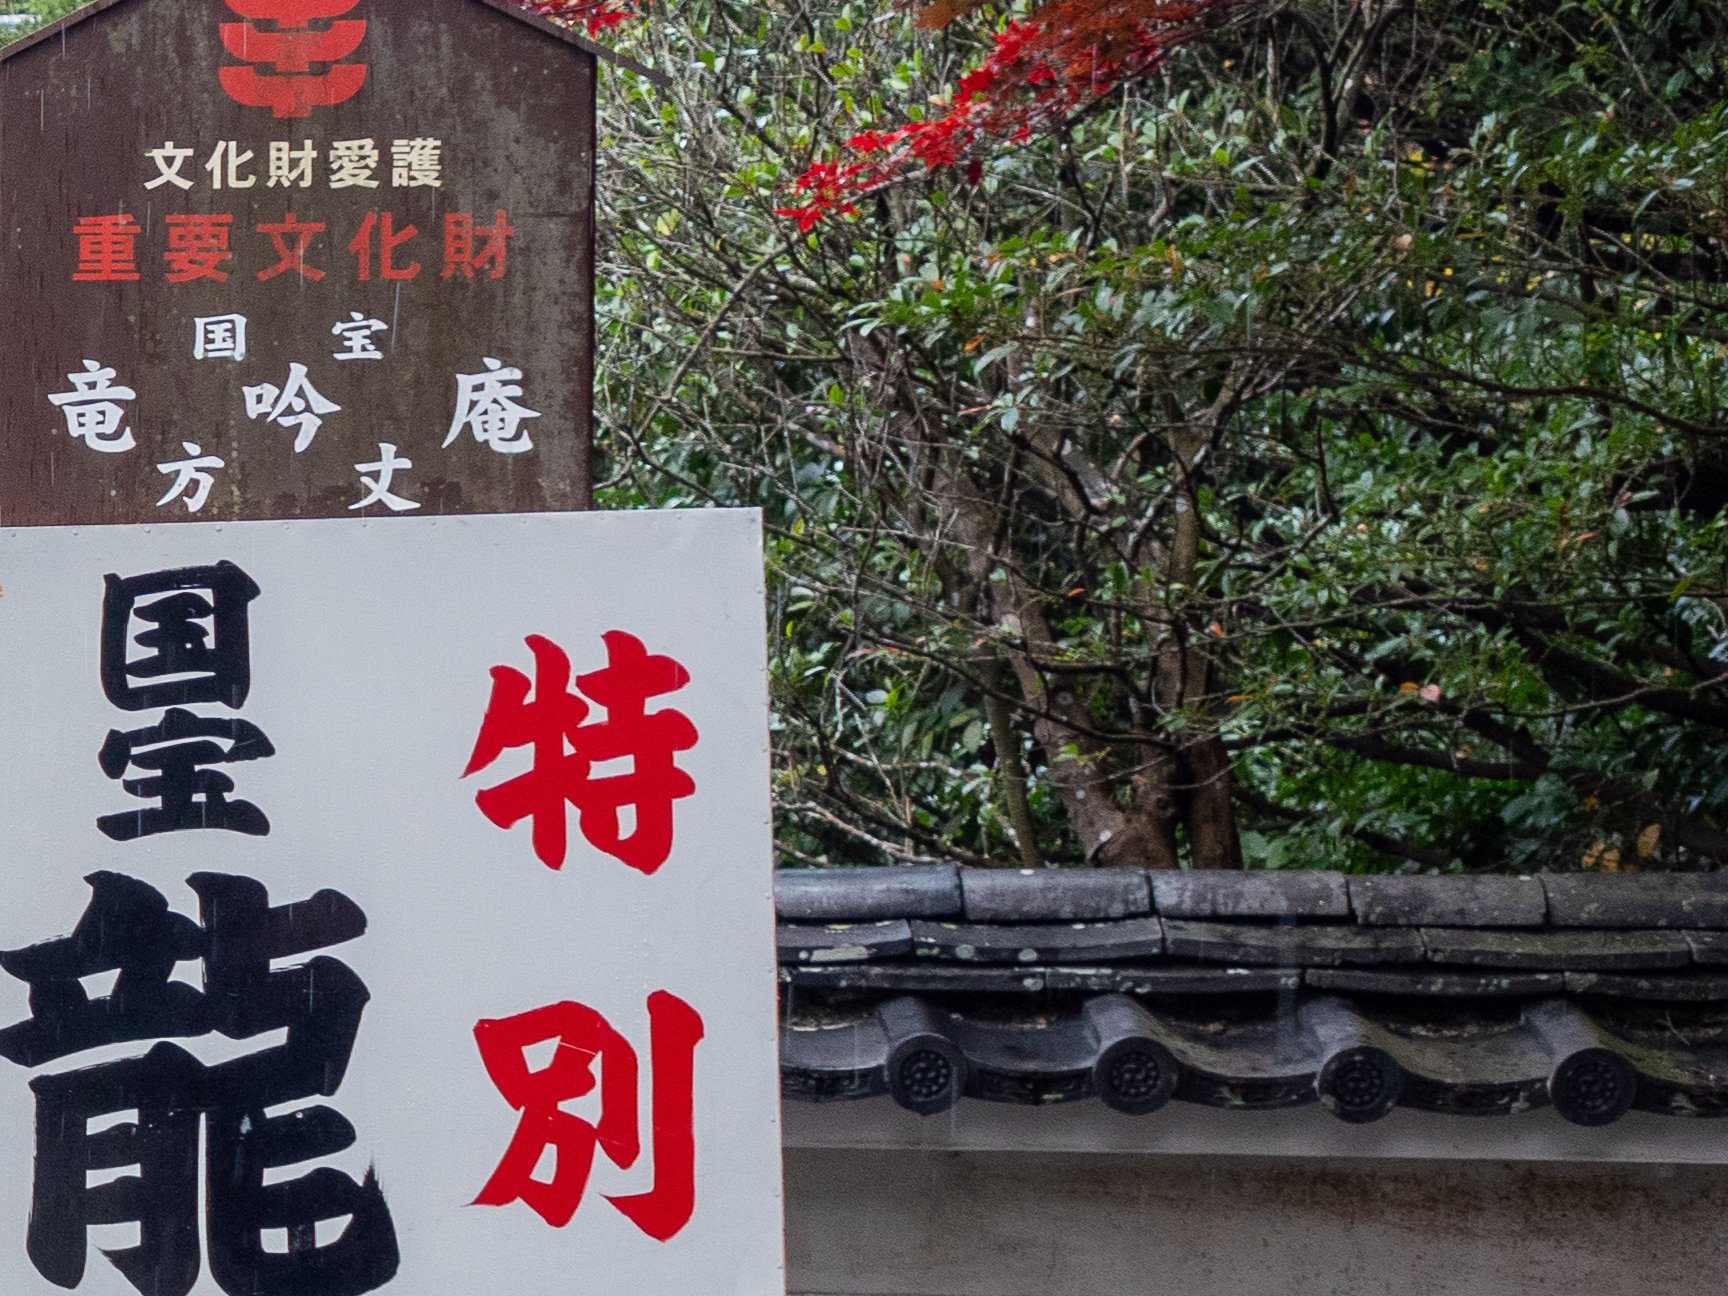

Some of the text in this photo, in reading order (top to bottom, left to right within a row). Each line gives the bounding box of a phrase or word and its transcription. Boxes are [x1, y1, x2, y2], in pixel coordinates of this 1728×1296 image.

[144, 137, 442, 190] 文化財愛護
[71, 211, 514, 284] 重要文化財
[192, 311, 389, 362] 国宝
[47, 357, 542, 454] 竜吟庵
[155, 441, 422, 512] 方丈
[97, 560, 275, 841] 国宝
